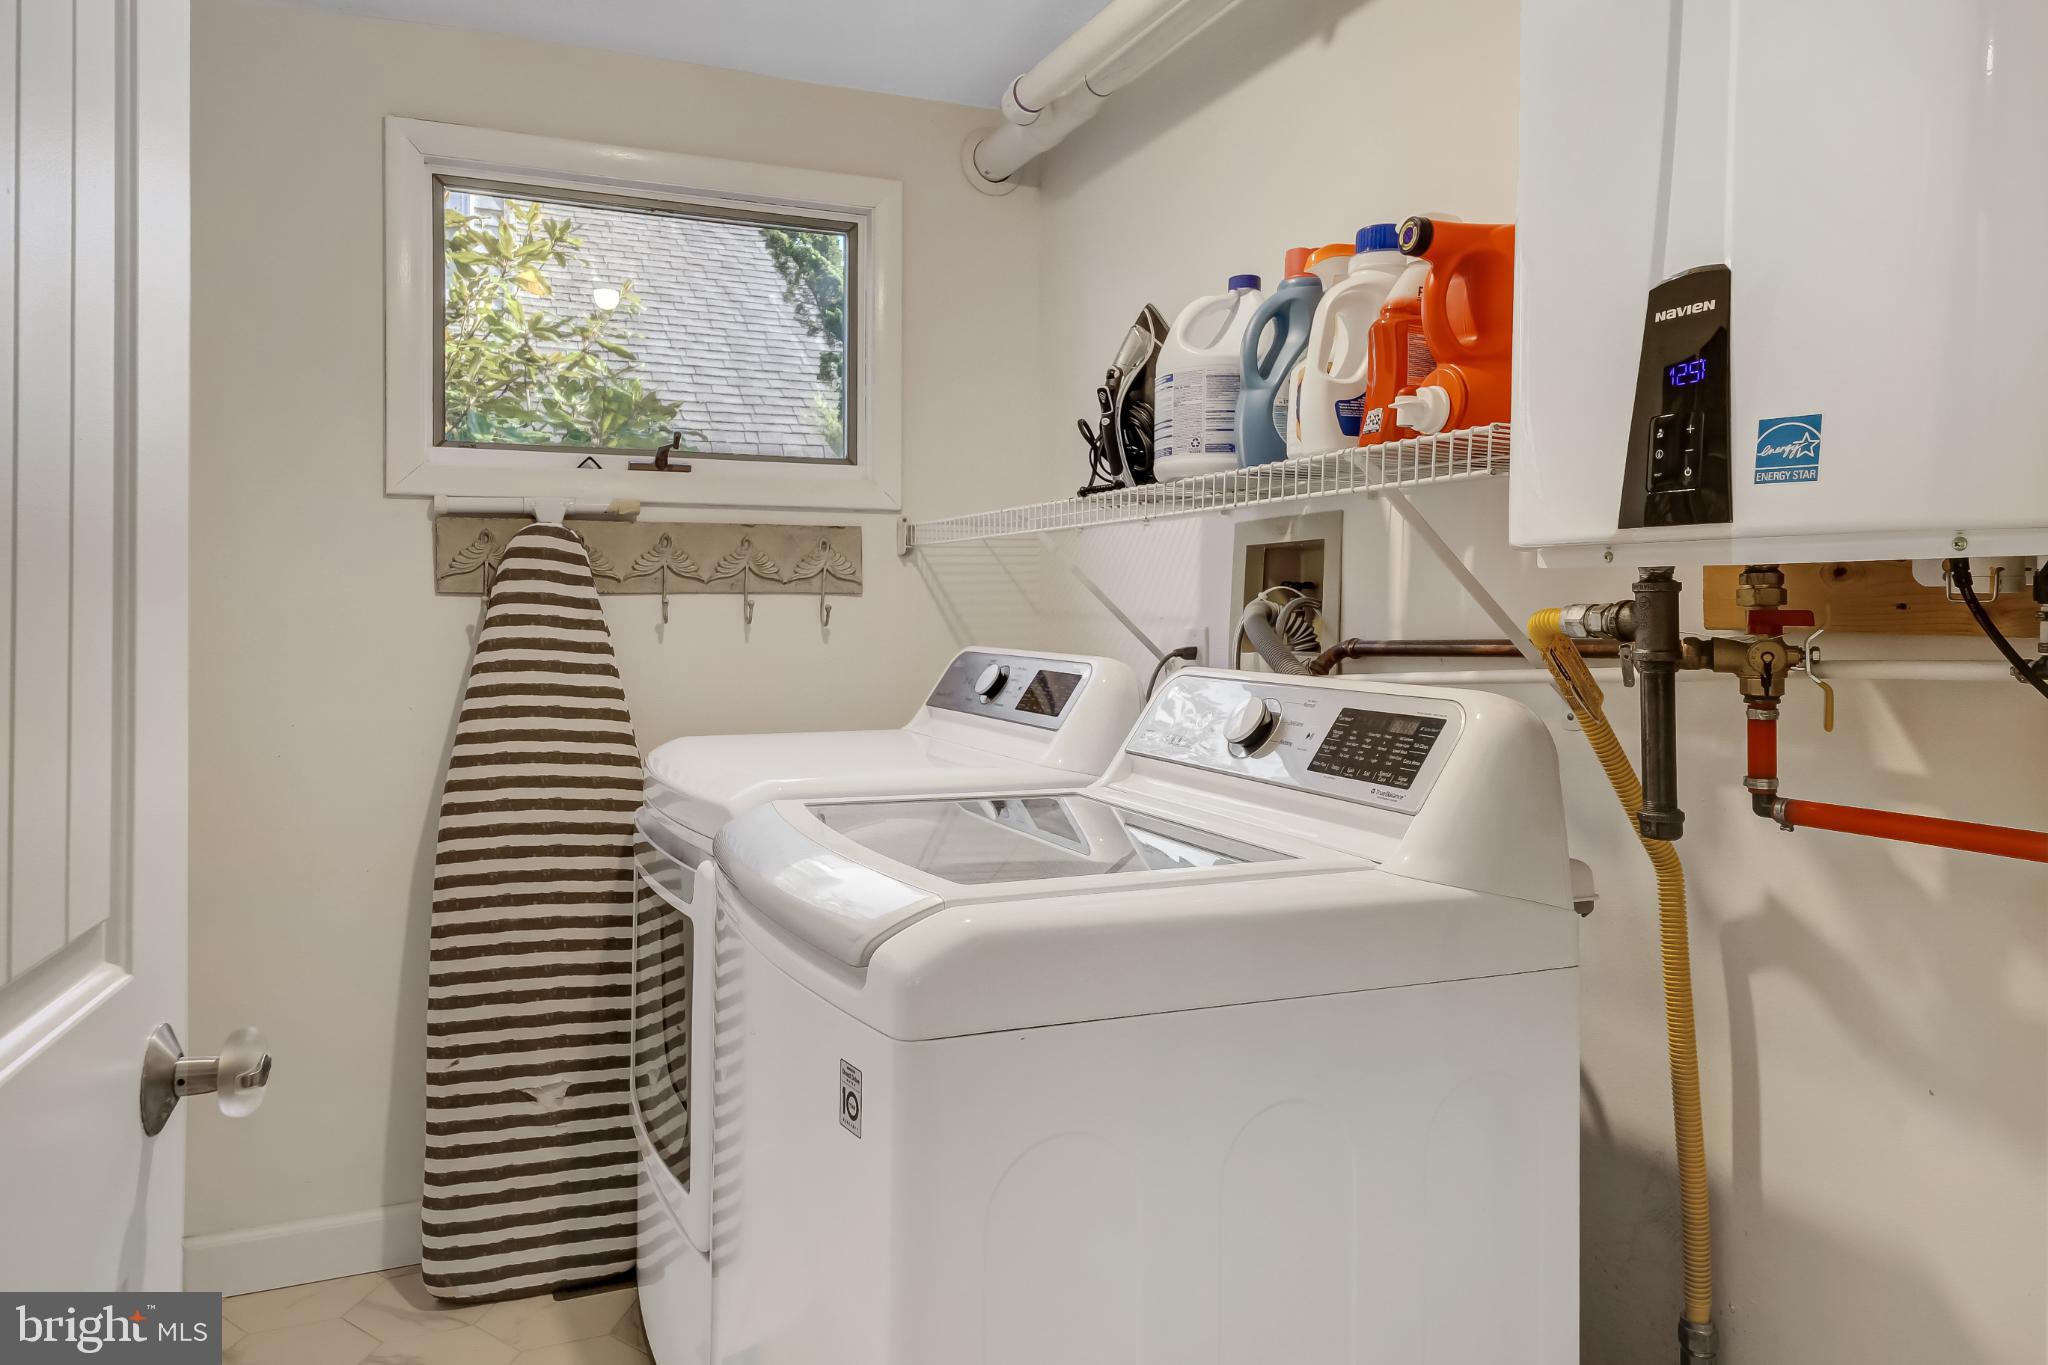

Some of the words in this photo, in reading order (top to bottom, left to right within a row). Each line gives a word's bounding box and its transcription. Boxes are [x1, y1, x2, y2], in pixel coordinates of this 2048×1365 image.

[1756, 471, 1791, 482] ENERGY
[1792, 469, 1817, 480] STAR
[842, 1086, 859, 1121] 10
